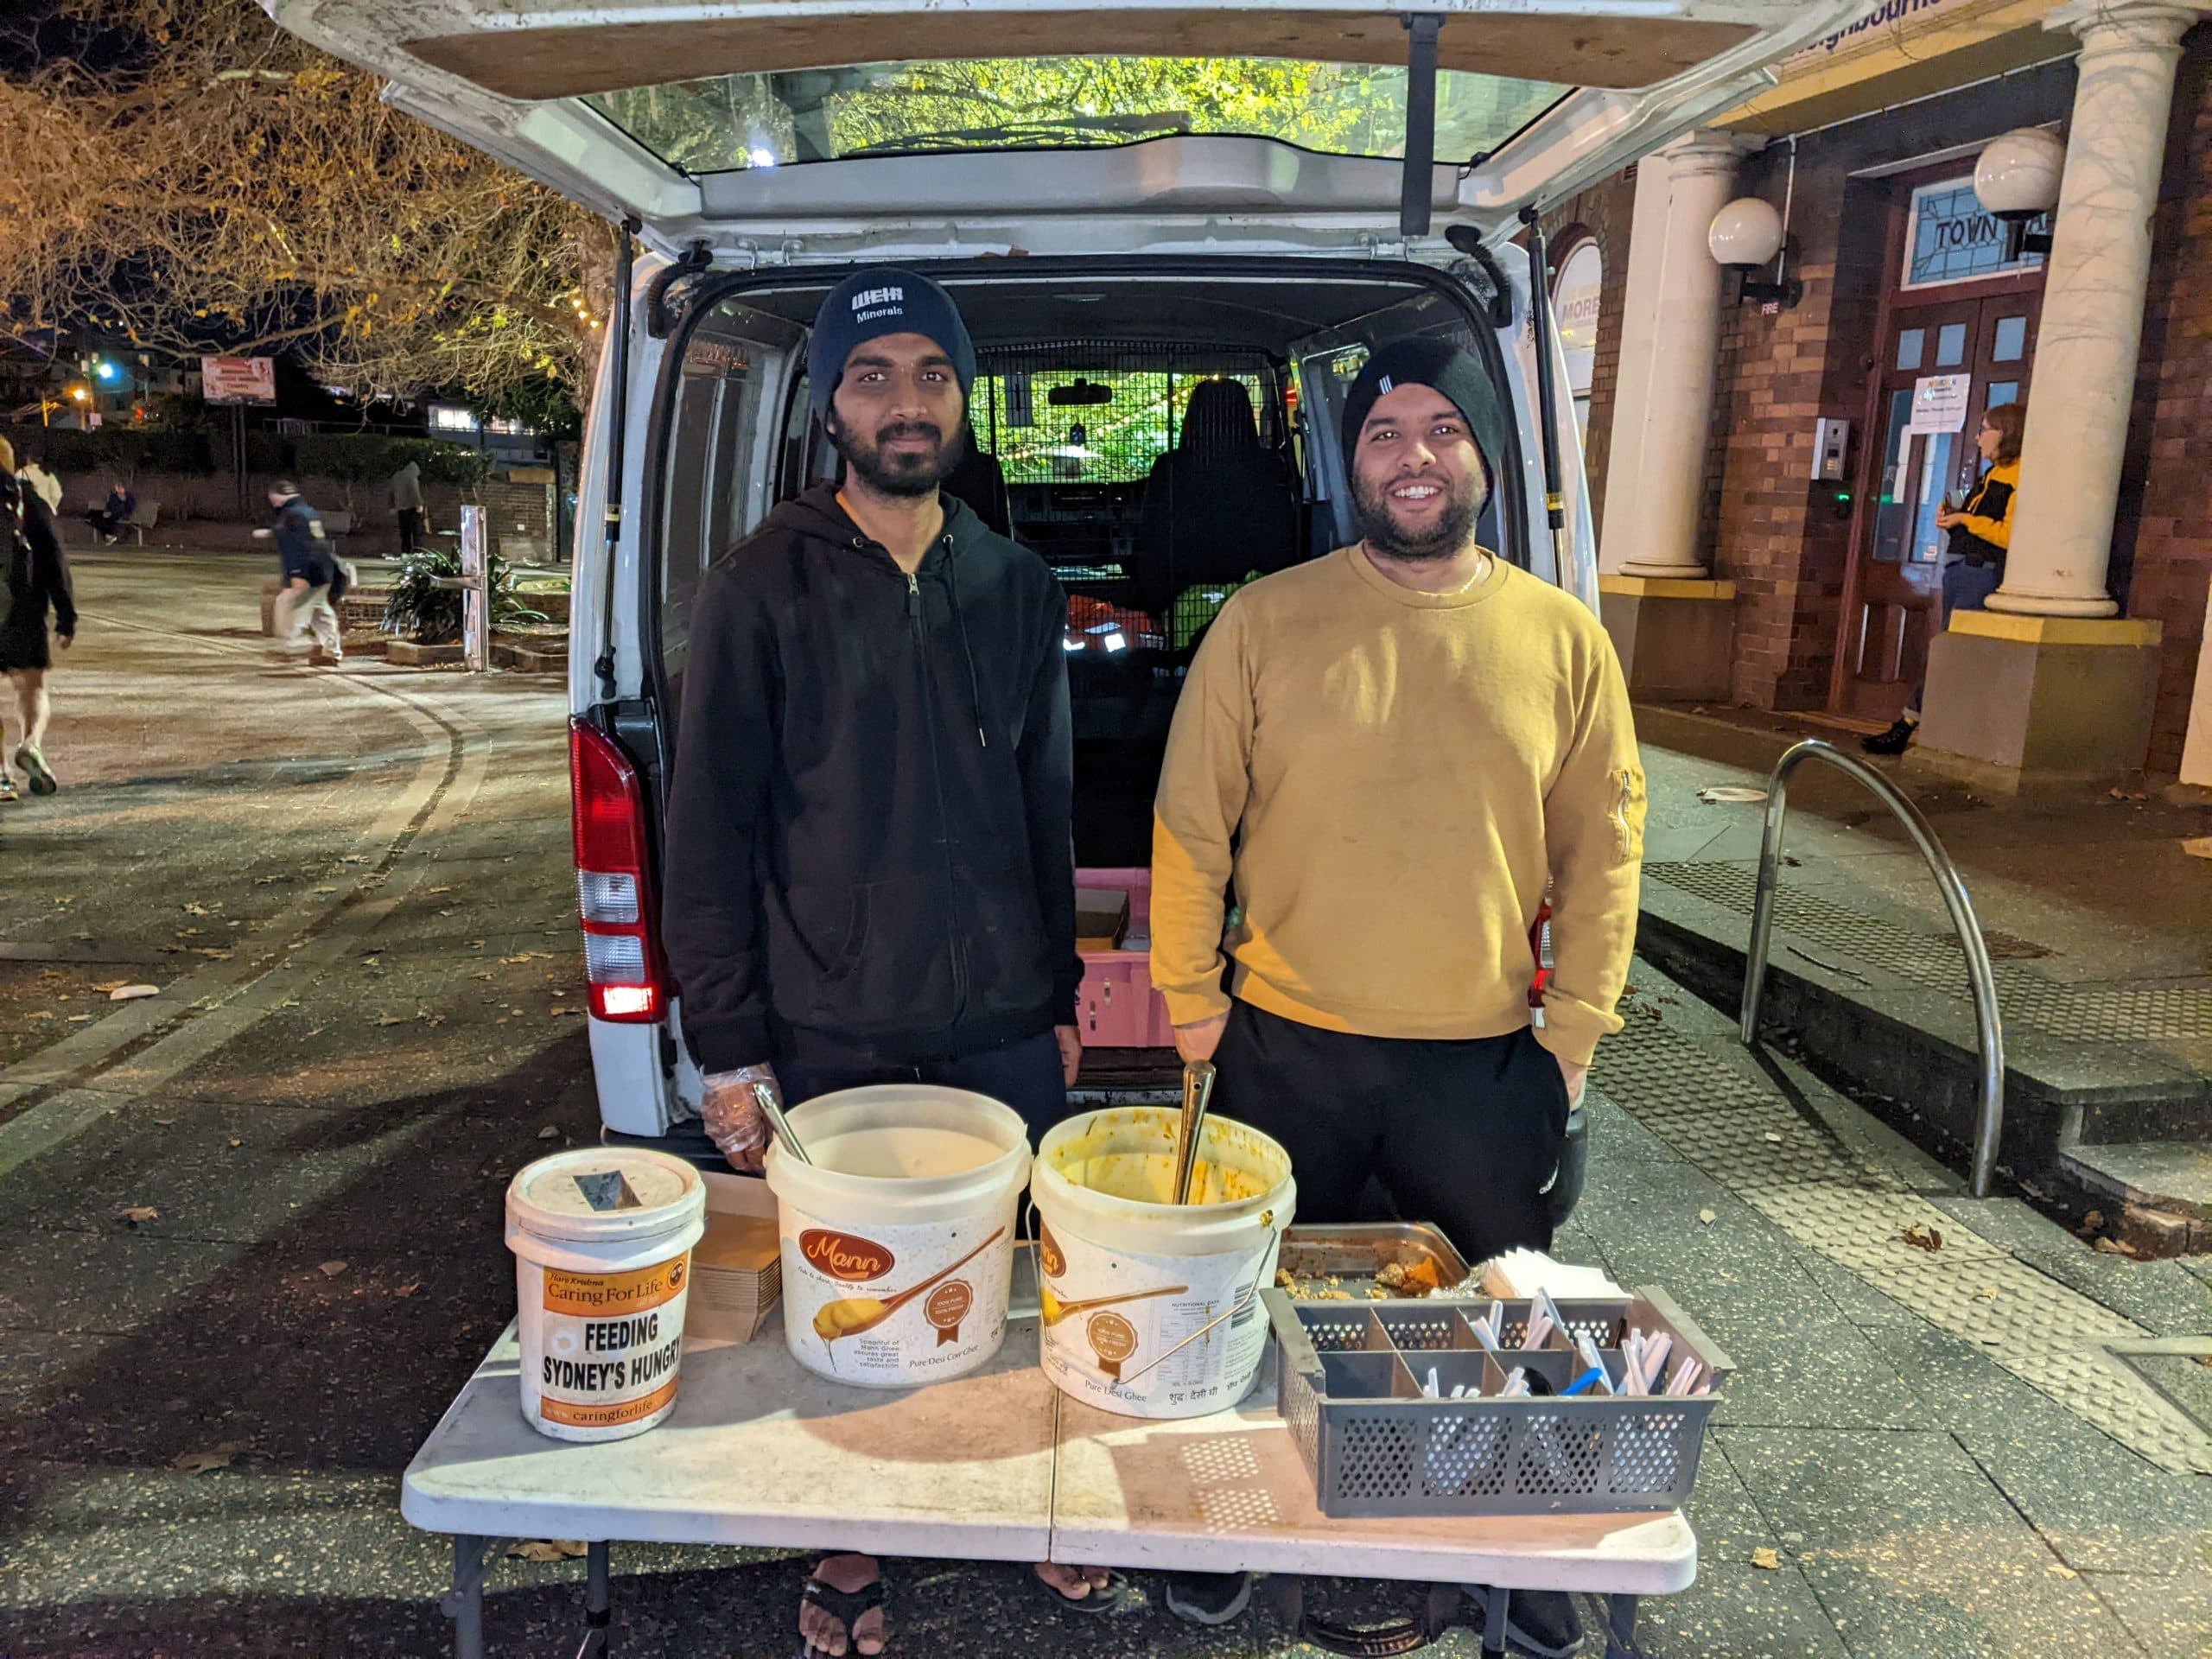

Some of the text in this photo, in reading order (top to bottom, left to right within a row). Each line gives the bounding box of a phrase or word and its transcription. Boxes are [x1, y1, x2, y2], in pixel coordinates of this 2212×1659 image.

[1936, 215, 1998, 250] TOWN
[852, 287, 904, 311] WEIR
[1562, 296, 1599, 321] MORE
[857, 305, 903, 324] Minerals
[807, 1236, 881, 1279] Mann
[548, 1283, 604, 1306] Caring
[607, 1288, 634, 1302] For
[637, 1278, 664, 1298] Life
[570, 1277, 604, 1287] Krishna
[585, 1313, 658, 1351] FEEDING
[543, 1333, 681, 1391] SYDNEY'S HUNGRY
[909, 1344, 979, 1368] Pure Desi Cow Ghee
[1085, 1379, 1103, 1392] Pure
[1124, 1389, 1147, 1402] Ghee
[573, 1401, 652, 1422] caringforlife
